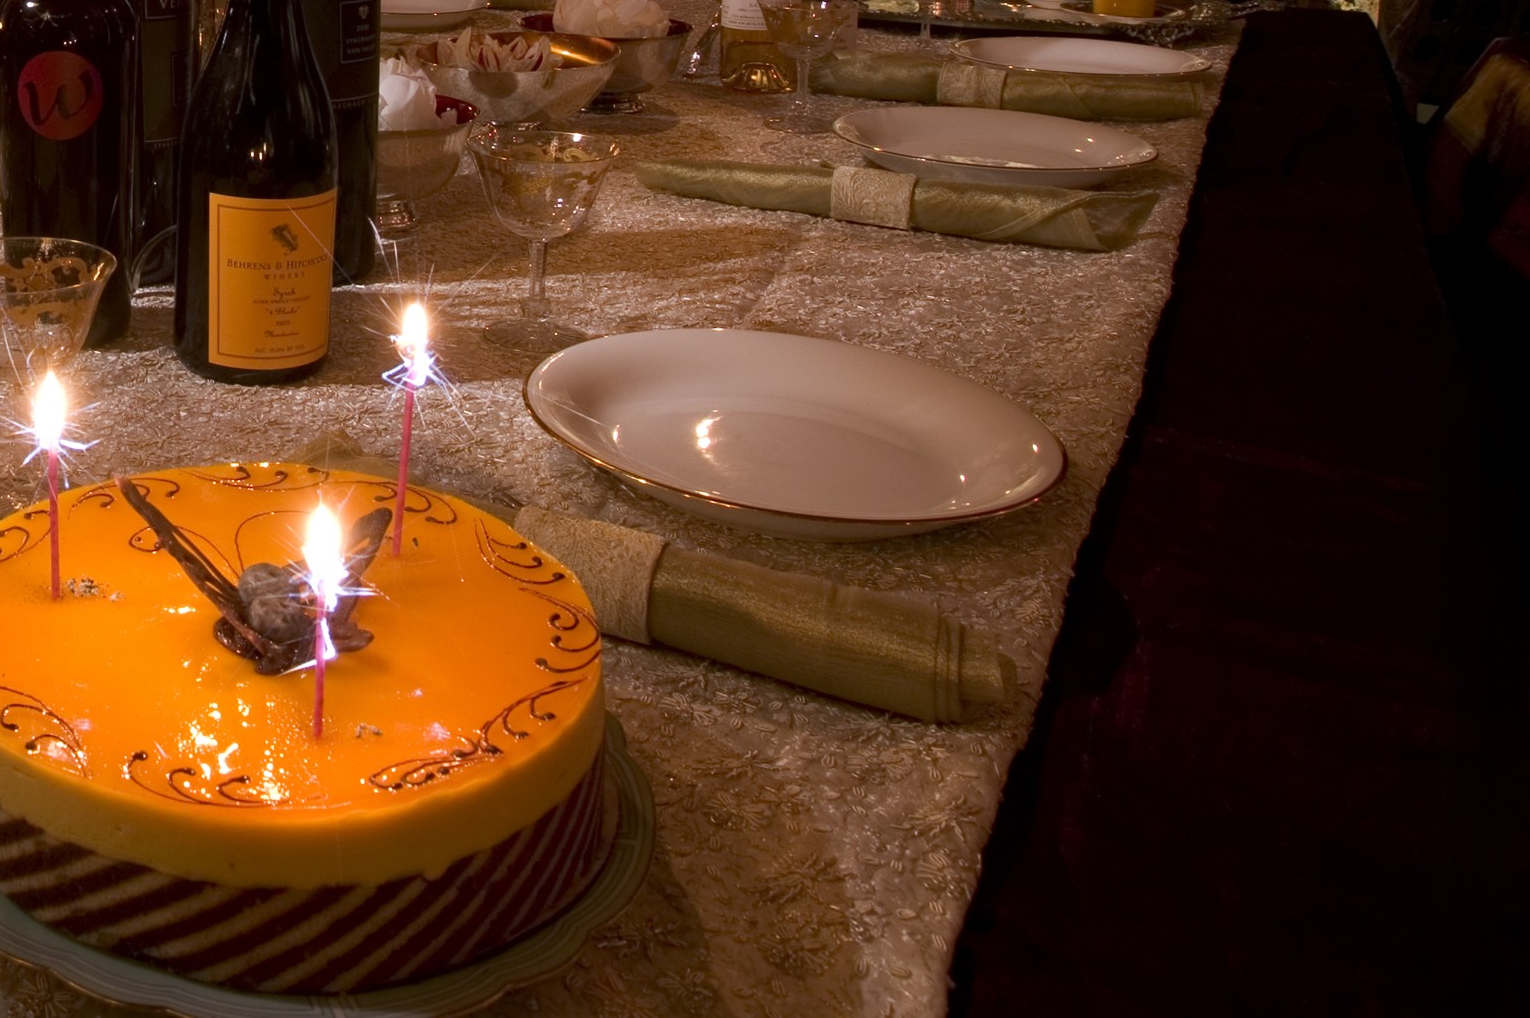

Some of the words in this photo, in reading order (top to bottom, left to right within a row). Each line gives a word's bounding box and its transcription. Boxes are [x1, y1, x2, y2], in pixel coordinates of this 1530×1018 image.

[227, 258, 271, 271] BEHRENS
[274, 261, 283, 270] &
[264, 271, 305, 280] WINERY
